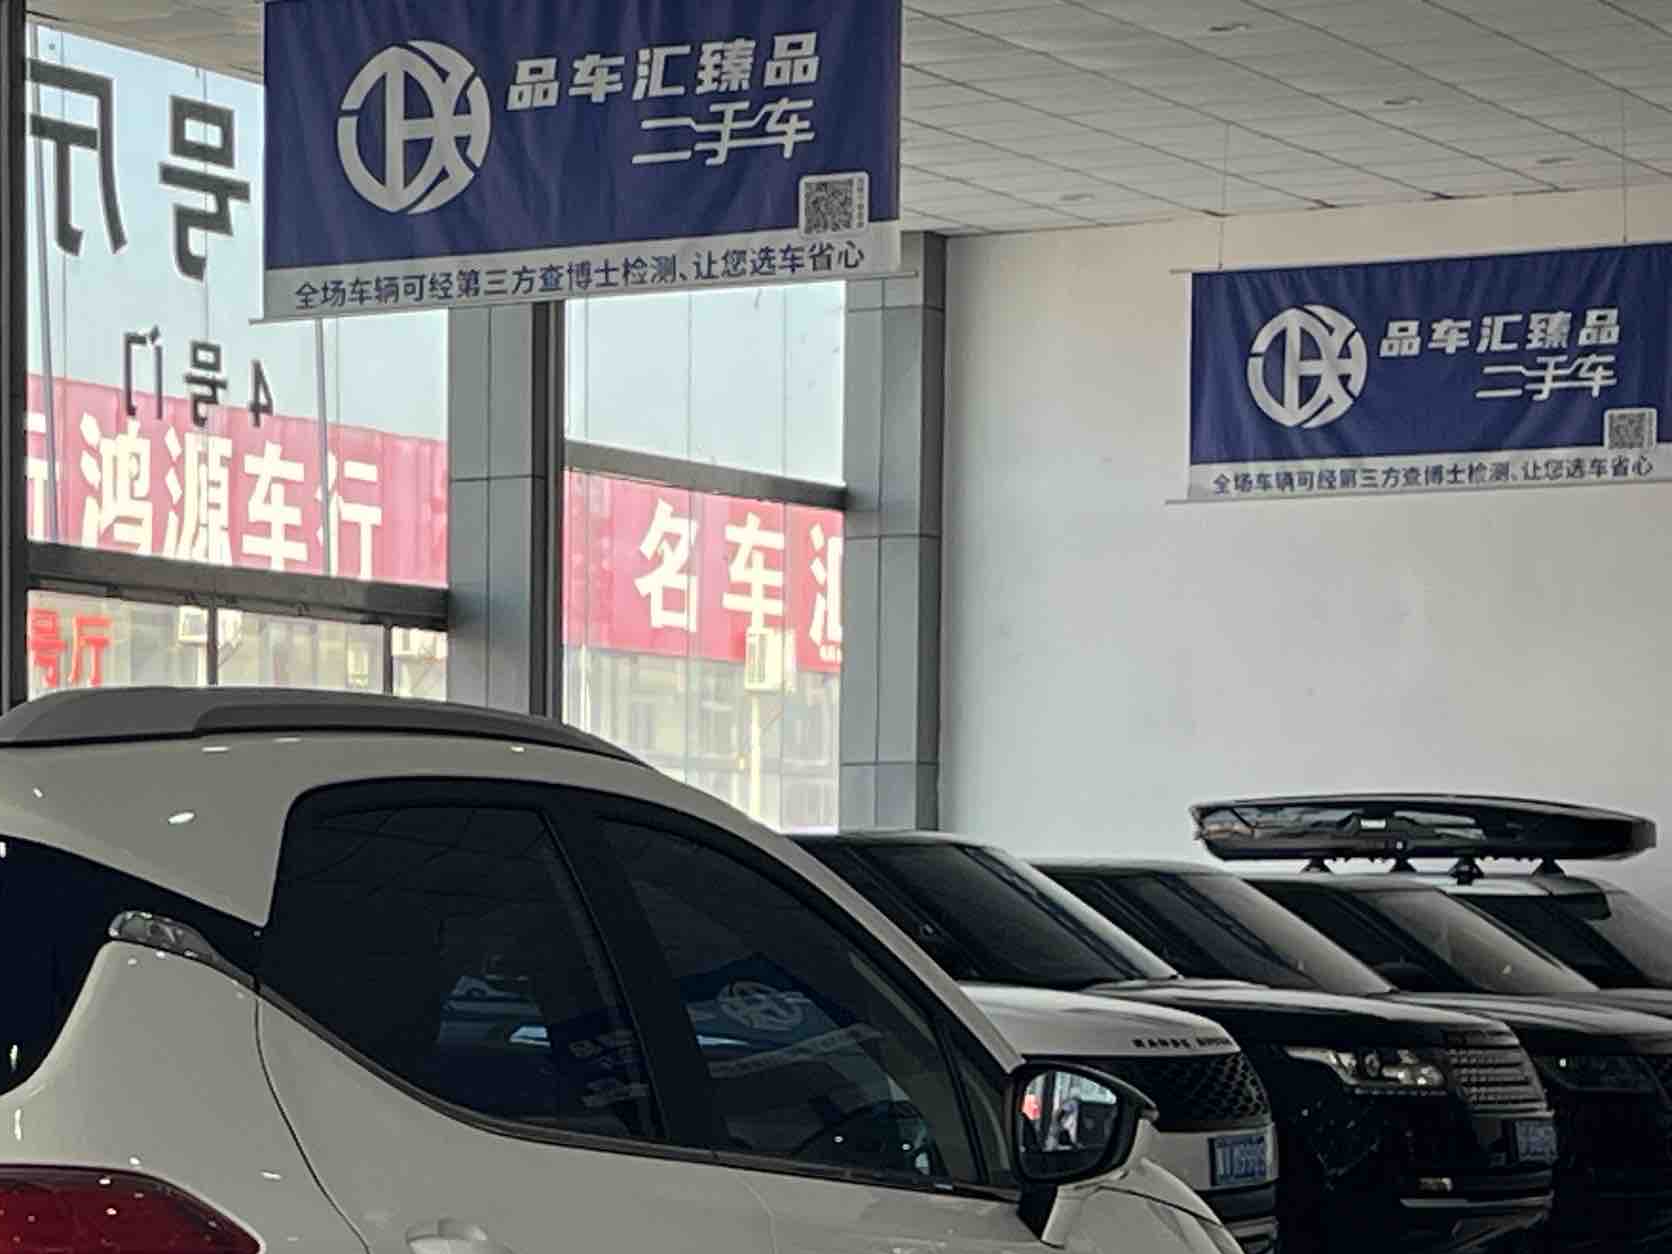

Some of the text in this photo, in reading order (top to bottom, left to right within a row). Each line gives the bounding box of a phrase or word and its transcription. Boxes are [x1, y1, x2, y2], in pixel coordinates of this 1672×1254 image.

[507, 32, 821, 111] 品车汇臻品
[631, 99, 815, 166] 二手车
[1379, 307, 1621, 358] 品车汇臻品
[1476, 355, 1617, 401] 二手车
[79, 410, 383, 580] 鸿源车行
